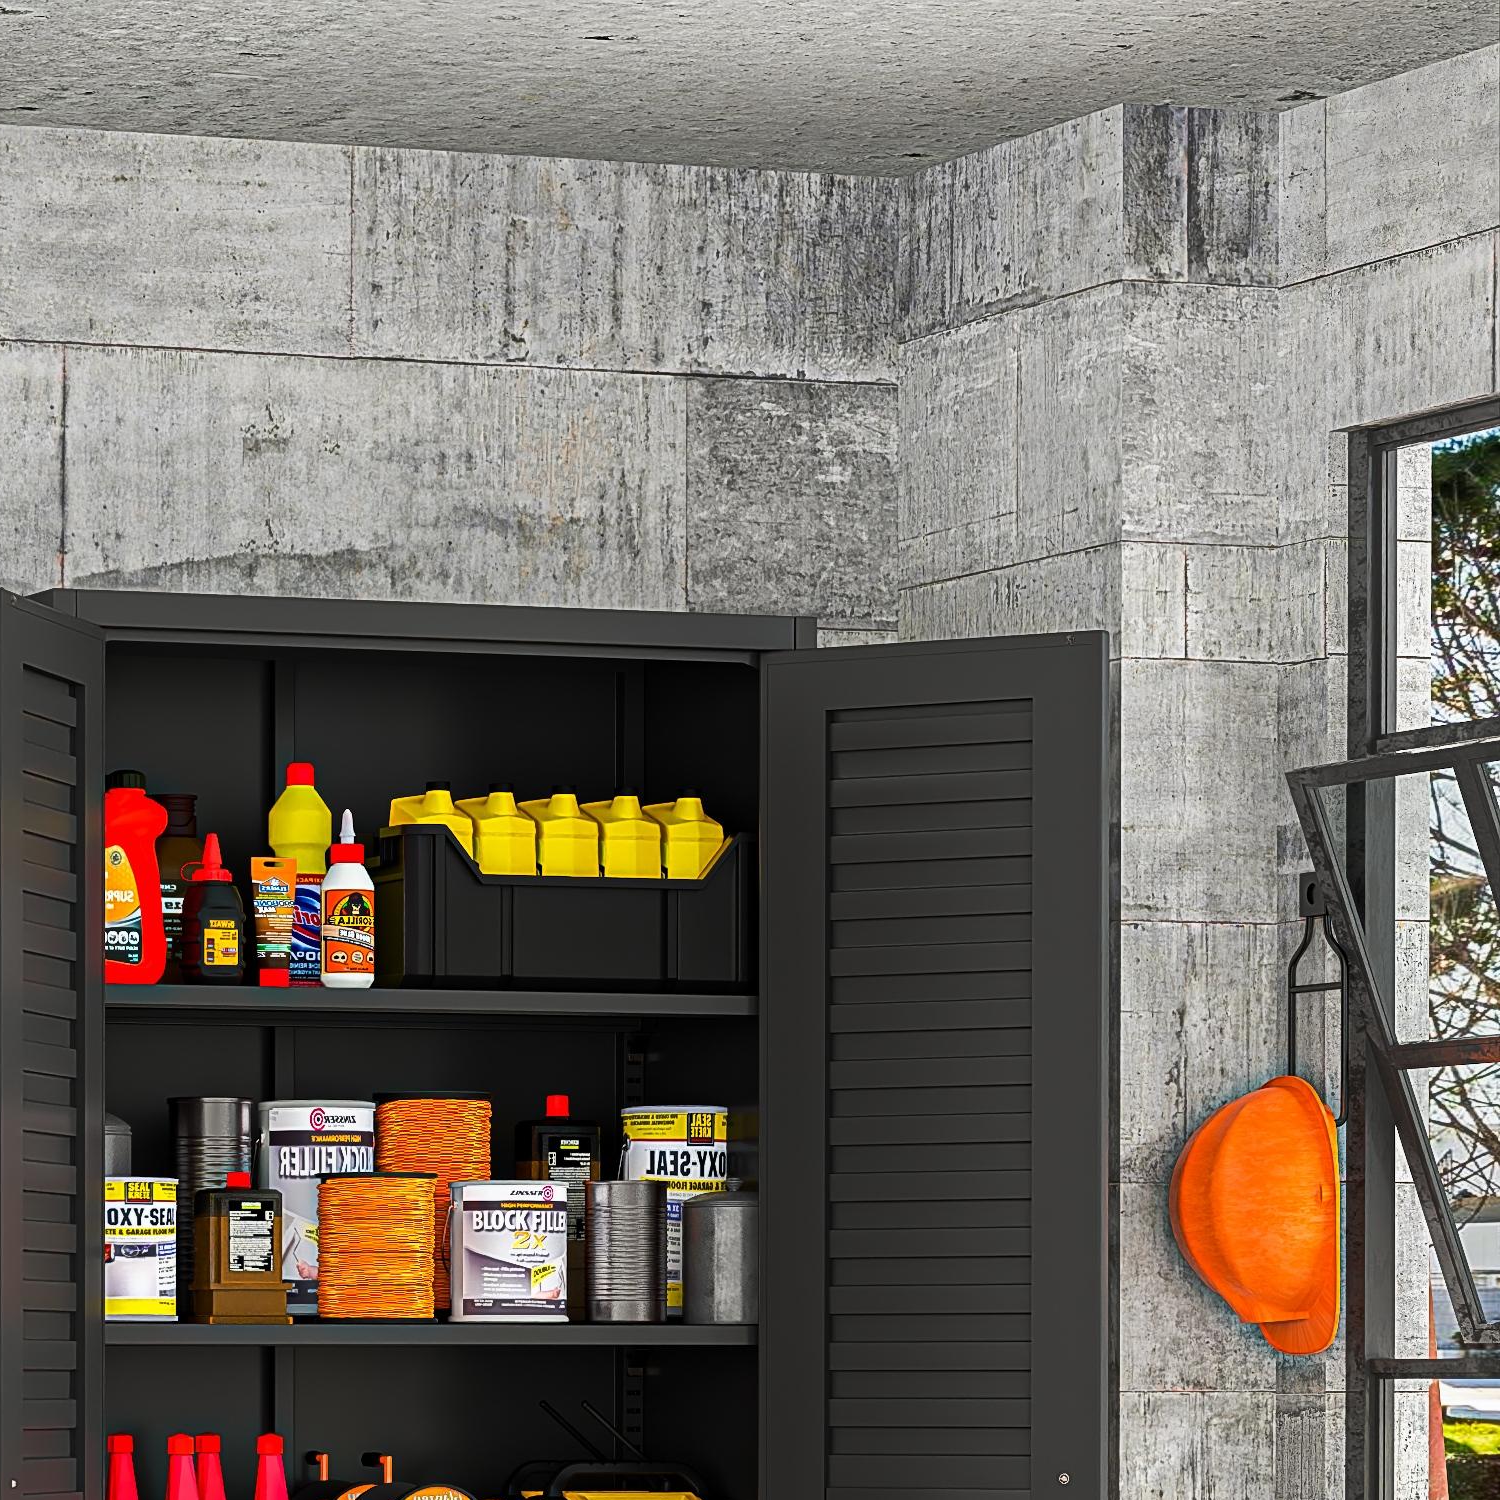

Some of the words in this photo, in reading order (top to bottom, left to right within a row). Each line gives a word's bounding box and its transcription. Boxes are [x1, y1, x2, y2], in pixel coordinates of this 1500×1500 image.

[127, 1182, 151, 1192] SEAL
[127, 1191, 151, 1200] KRETE
[472, 1210, 530, 1232] BLOCK
[126, 1228, 151, 1236] GARAGE
